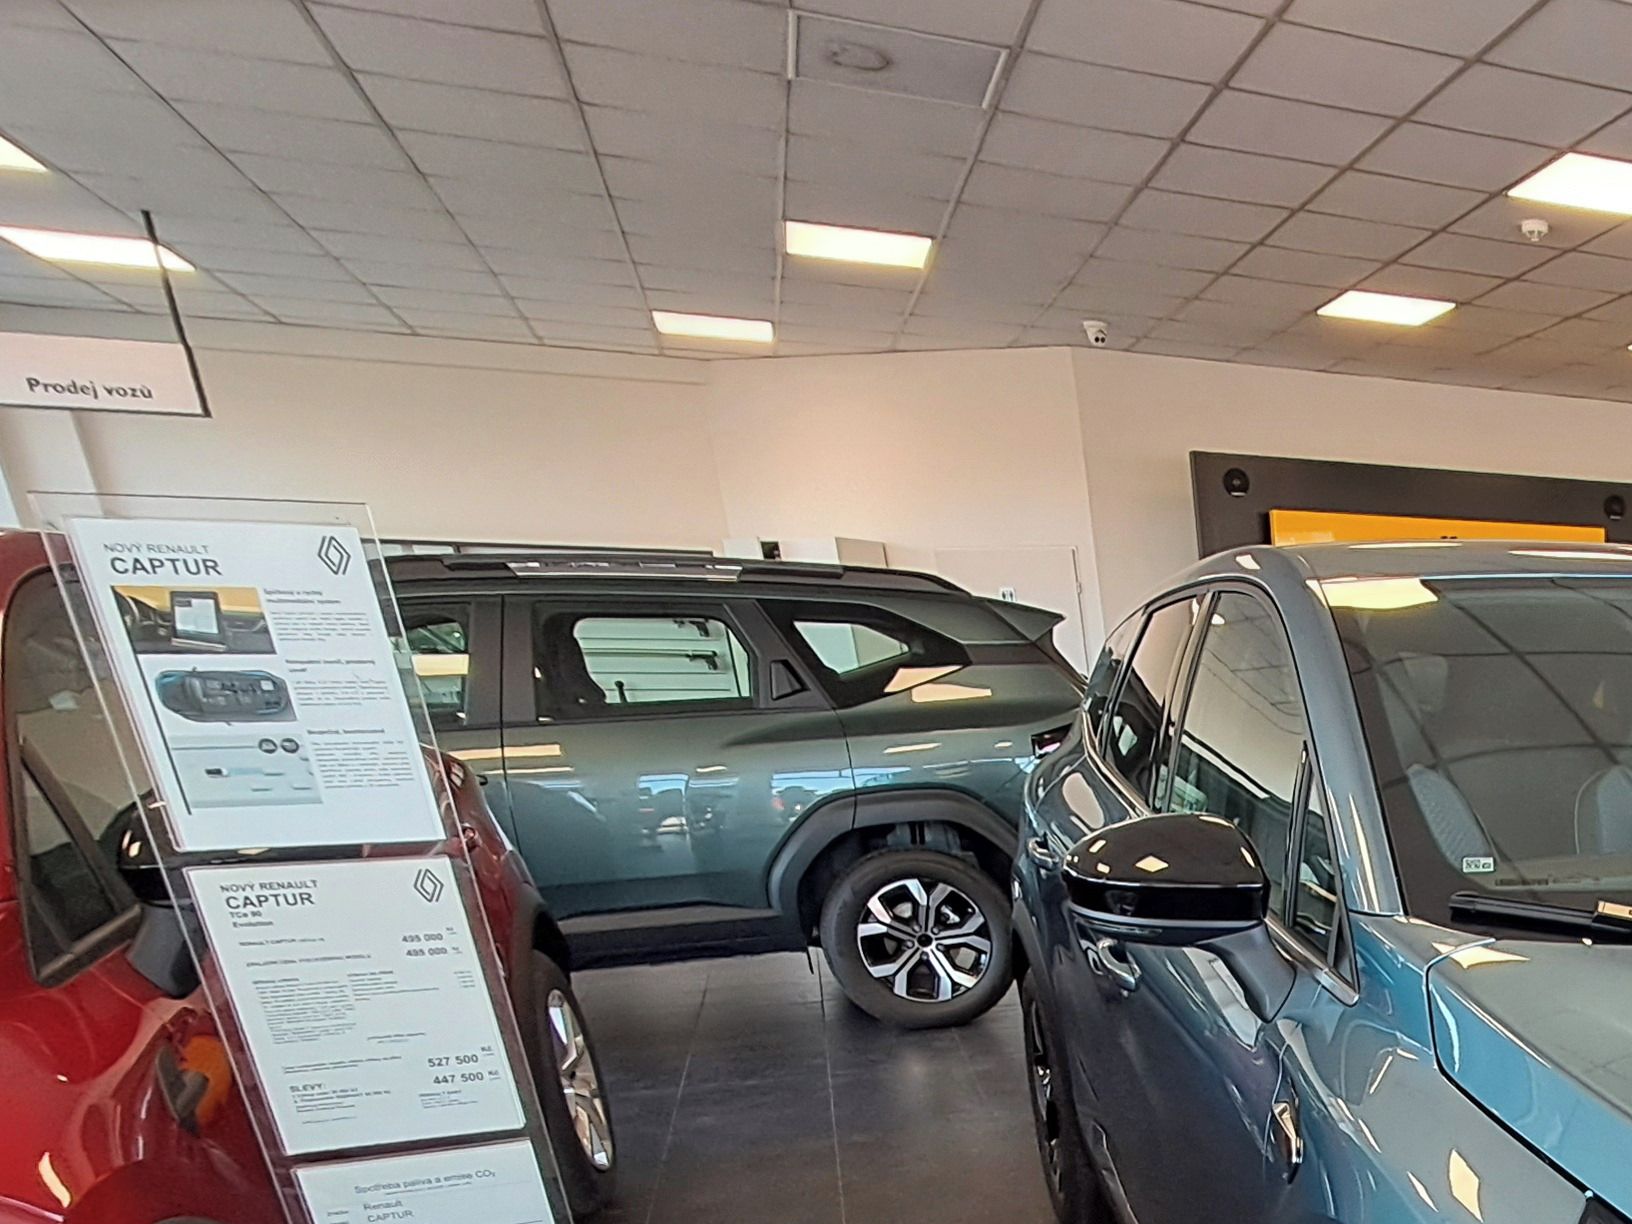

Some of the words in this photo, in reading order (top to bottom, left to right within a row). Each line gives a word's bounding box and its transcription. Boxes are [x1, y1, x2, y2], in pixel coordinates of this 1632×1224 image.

[25, 376, 99, 400] Prodej
[102, 383, 153, 399] vozů
[146, 544, 210, 555] RENAULT
[110, 557, 223, 576] CAPTUR
[258, 879, 319, 892] RENAULT
[225, 892, 315, 910] CAPTUR
[428, 1056, 450, 1068] 527
[455, 1053, 479, 1066] 500
[433, 1074, 456, 1085] 447
[460, 1071, 484, 1083] 500
[363, 1200, 403, 1211] Renault
[367, 1209, 414, 1223] CAPTUR
